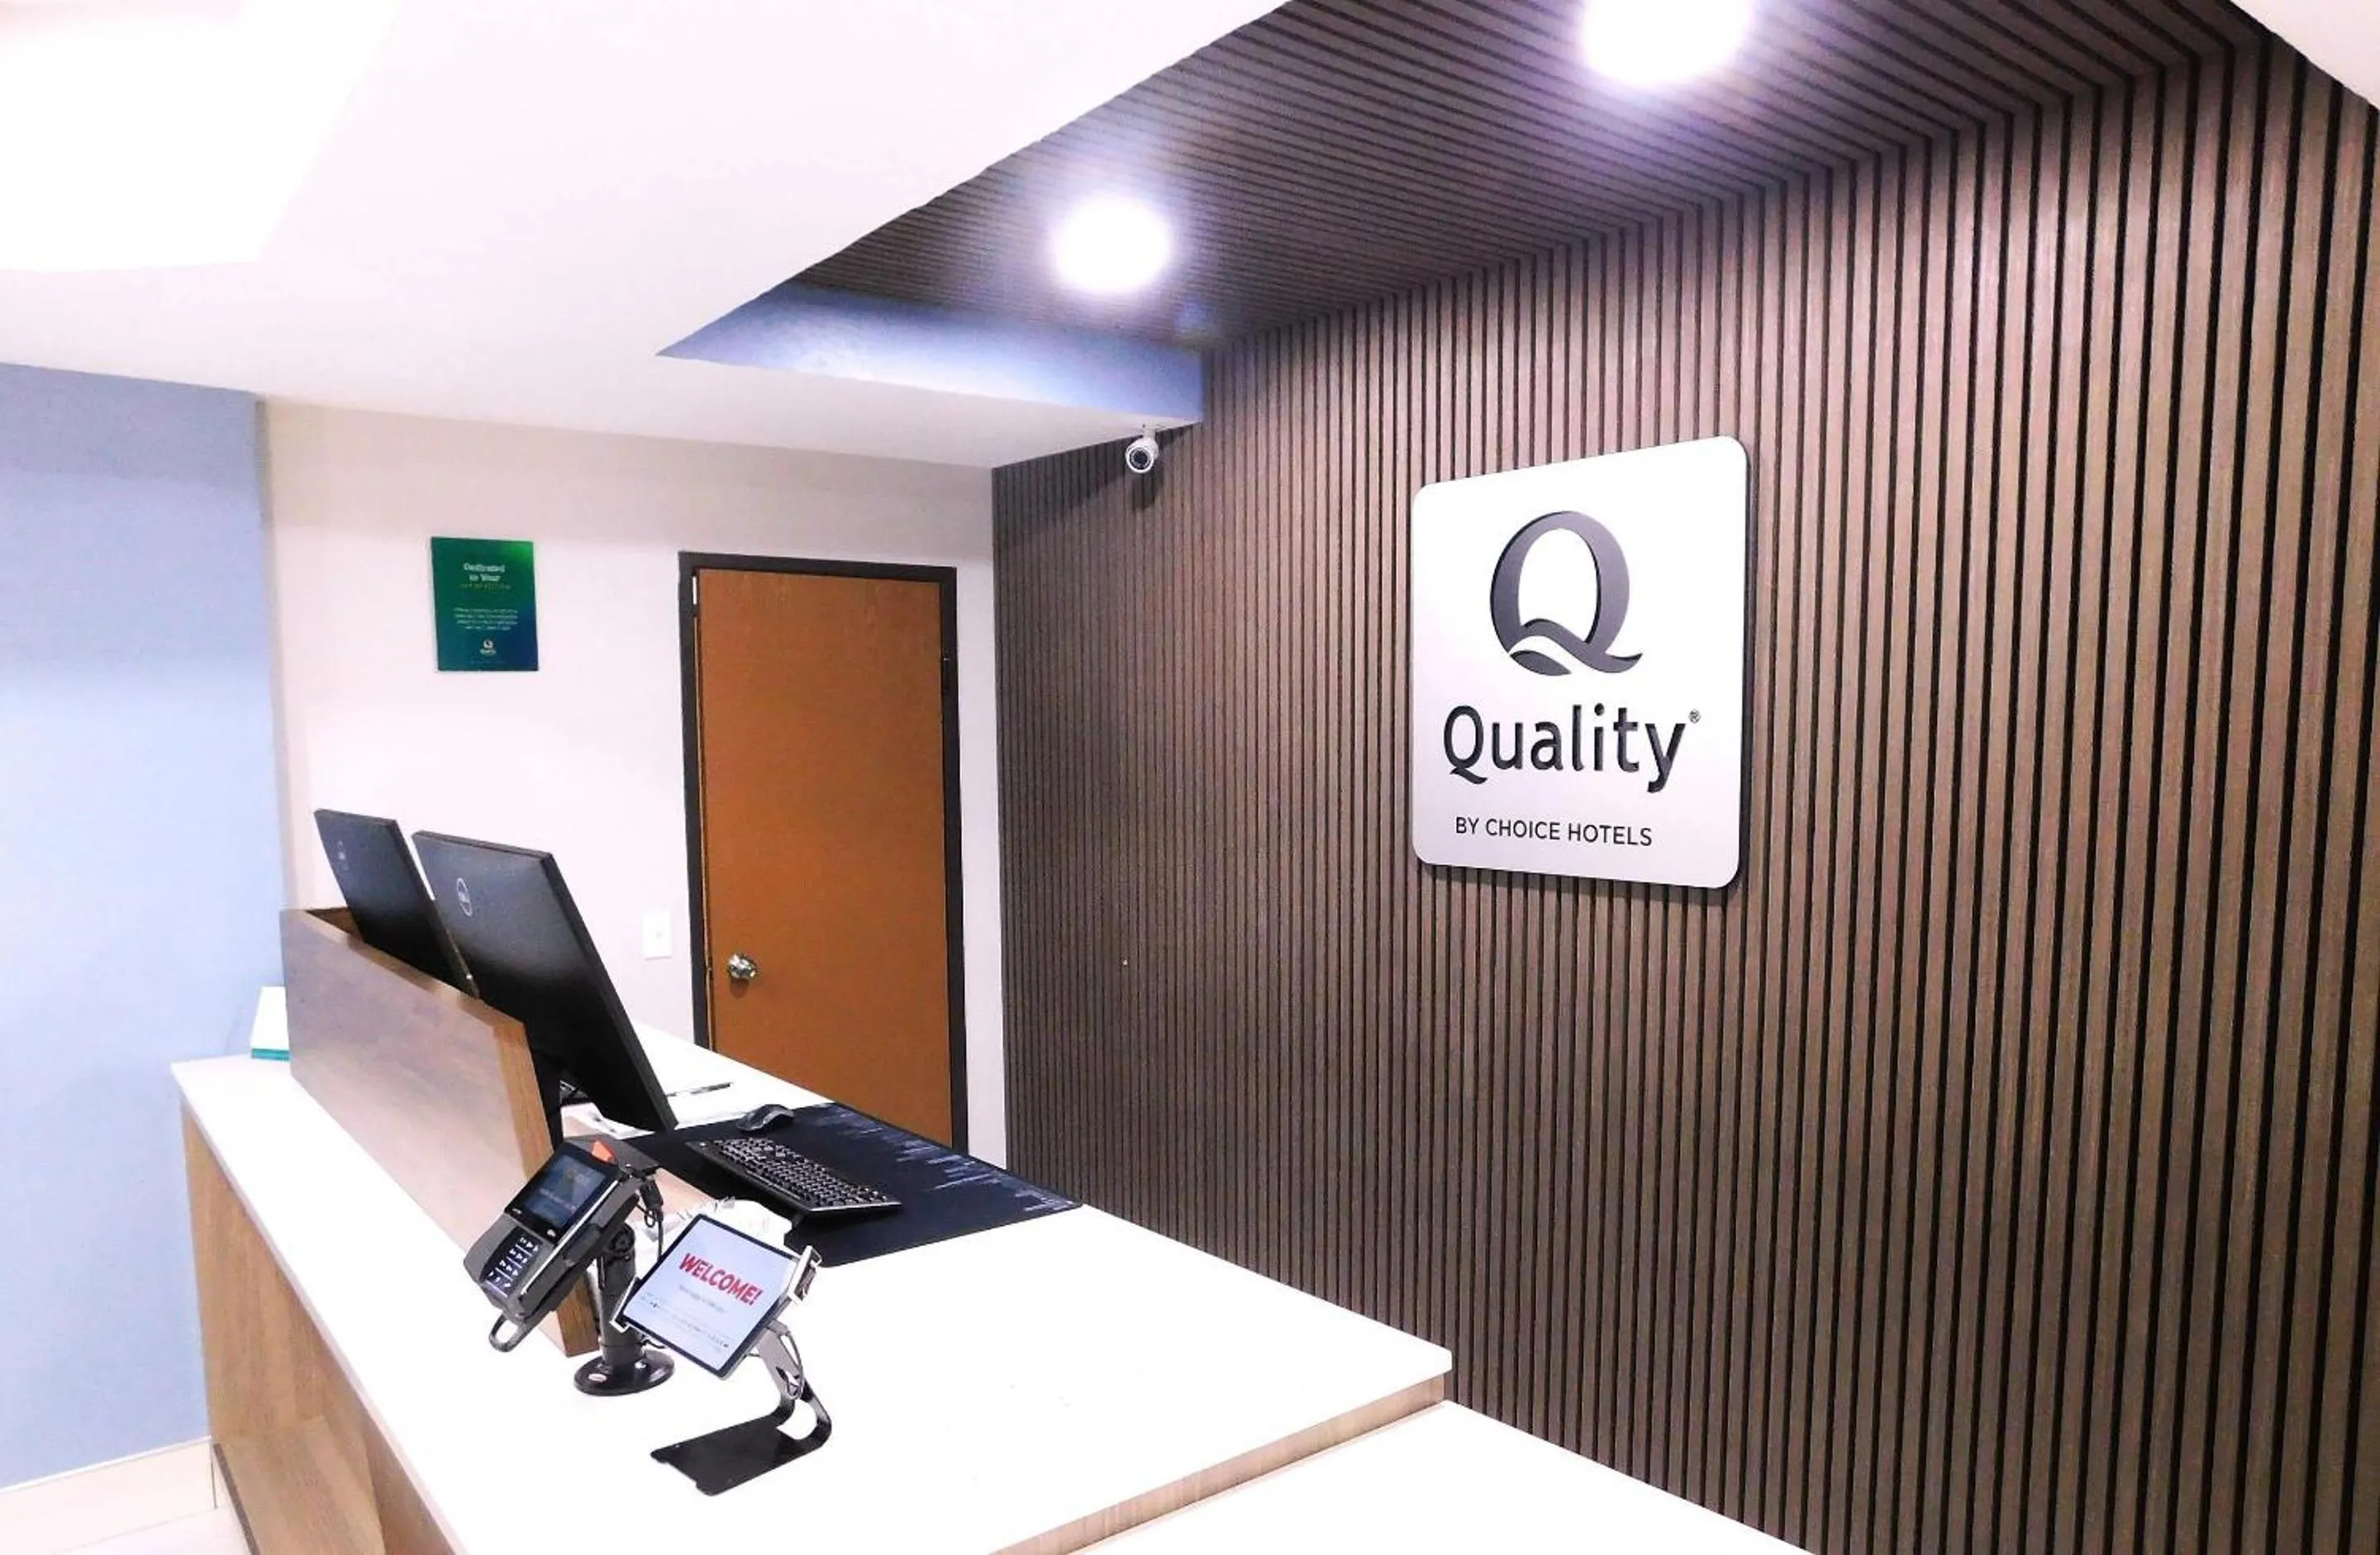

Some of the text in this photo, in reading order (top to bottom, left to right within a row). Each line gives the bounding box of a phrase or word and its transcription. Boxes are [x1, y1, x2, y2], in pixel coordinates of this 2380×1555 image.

[1489, 510, 1644, 677] Q
[1456, 816, 1653, 847] BY CHOICE HOTELS
[678, 1253, 764, 1305] WELCOME!
